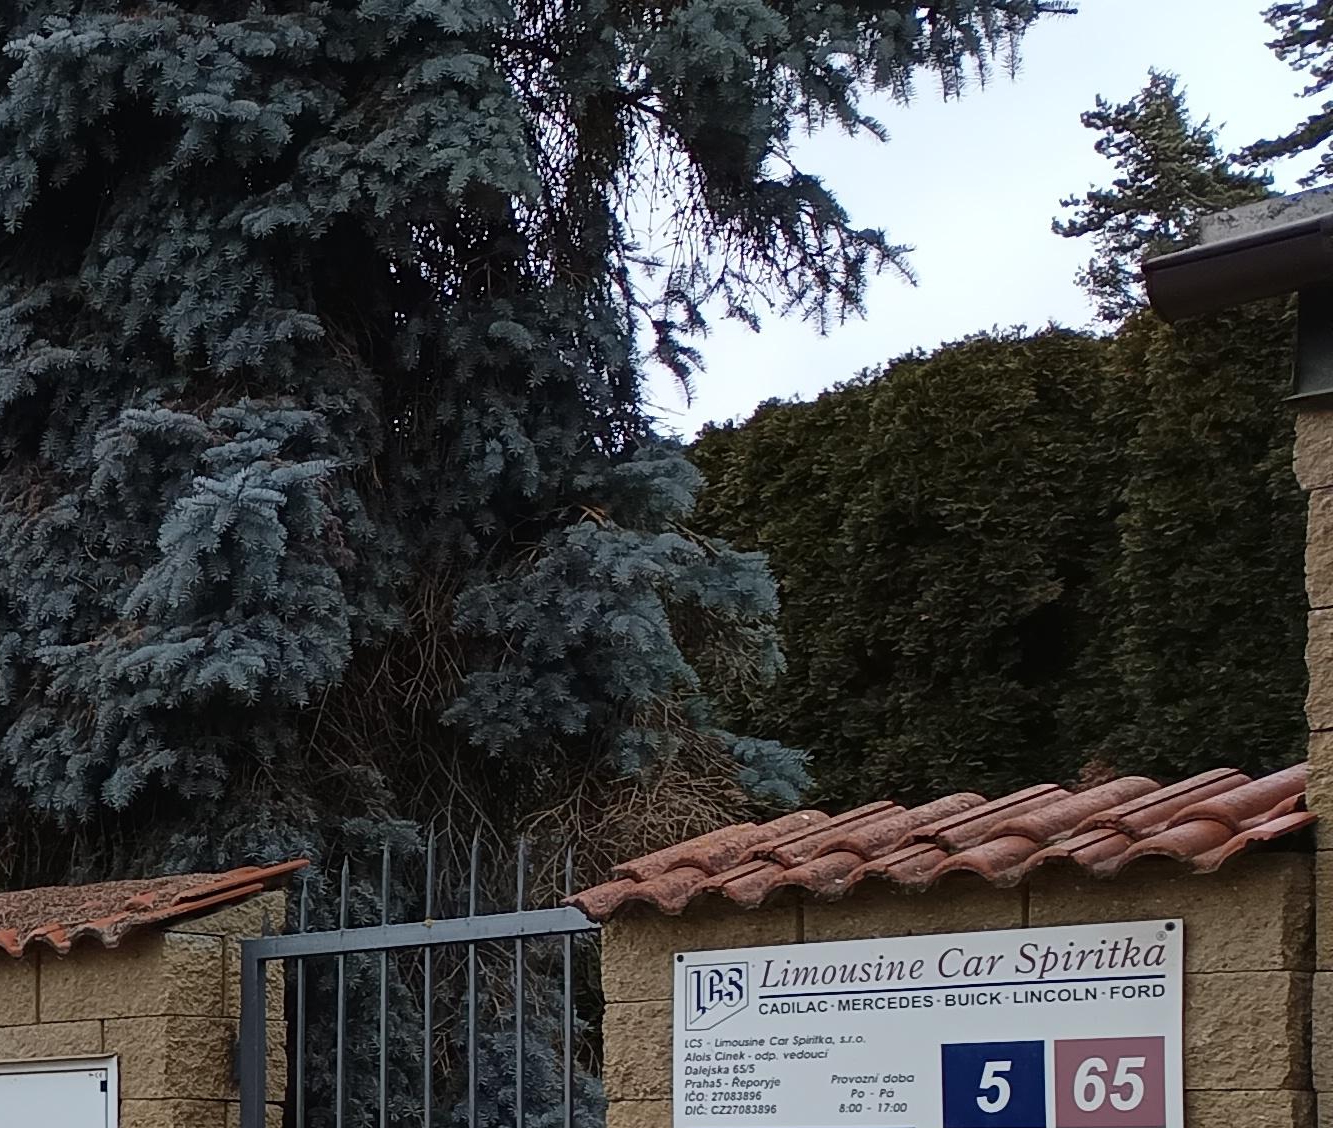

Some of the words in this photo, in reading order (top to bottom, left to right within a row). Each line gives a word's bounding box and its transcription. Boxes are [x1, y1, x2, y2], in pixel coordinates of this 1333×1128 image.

[759, 954, 925, 989] Limousine
[938, 947, 1004, 979] Car
[714, 1037, 766, 1048] Limousine
[769, 1036, 789, 1046] Car
[839, 1035, 866, 1044] s.r.o.
[732, 1063, 756, 1074] 65/5
[830, 1073, 880, 1084] Provozní
[882, 1074, 915, 1083] doba
[1073, 1056, 1146, 1112] 65
[976, 1060, 1012, 1113] 5
[711, 1091, 762, 1102] 27083896
[850, 1088, 865, 1098] Po
[711, 1104, 777, 1115] CZ27083896
[838, 1102, 863, 1113] 8:00
[877, 1102, 908, 1113] 17:00
